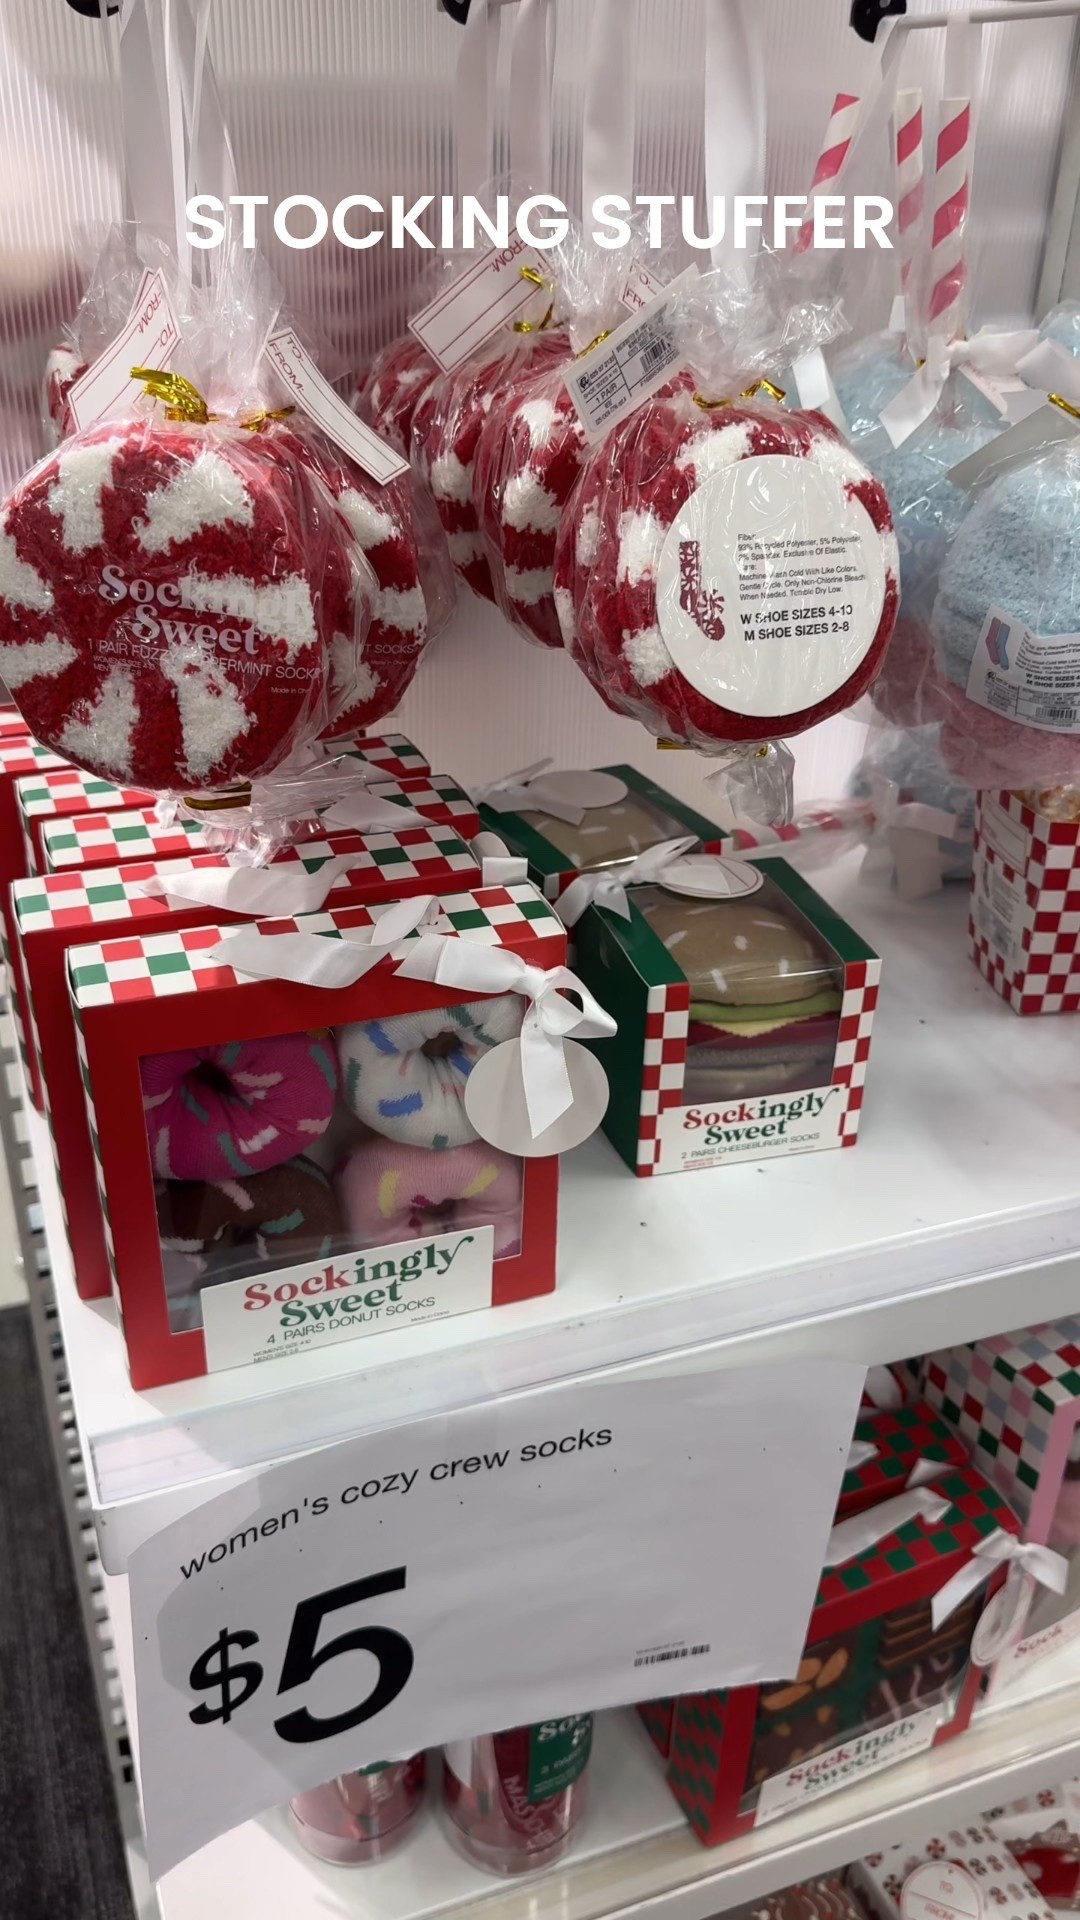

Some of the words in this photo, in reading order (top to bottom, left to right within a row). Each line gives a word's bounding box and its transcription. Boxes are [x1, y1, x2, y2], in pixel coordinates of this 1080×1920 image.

[159, 323, 174, 348] TO:
[286, 337, 304, 363] TO:
[269, 342, 305, 392] FROM:
[601, 382, 618, 400] PAIR
[815, 547, 824, 555] Of
[825, 546, 848, 555] Elastic.
[820, 537, 831, 545] 5%
[739, 573, 766, 581] Machine
[788, 568, 804, 577] Cold
[805, 567, 820, 576] With
[821, 565, 835, 574] Like
[740, 583, 762, 591] Gentle
[784, 579, 800, 588] Only
[801, 576, 843, 587] Non-Chlorine
[844, 574, 866, 583] Bleach
[740, 592, 760, 601] When
[815, 586, 828, 595] Dry
[827, 585, 844, 594] Low.
[740, 613, 752, 625] W
[755, 610, 789, 624] SHOE
[791, 606, 826, 621] SIZES
[828, 604, 853, 618] 4-10
[132, 604, 260, 655] Sweet
[744, 630, 755, 641] M
[758, 626, 792, 640] SHOE
[795, 622, 829, 637] SIZES
[831, 621, 850, 633] 2-8
[88, 638, 93, 650] 1
[98, 639, 128, 656] PAIR
[131, 644, 178, 662] FUZZY
[183, 650, 272, 677] PPERMINT
[374, 644, 414, 654] SOCKS
[683, 1087, 840, 1130] Sockingly
[704, 1119, 787, 1145] Sweet
[681, 1151, 688, 1159] 2
[691, 1147, 716, 1158] PAIRS
[717, 1138, 788, 1154] CHEESEBURGER
[789, 1132, 821, 1144] SOCKS
[244, 1236, 475, 1311] Sockingly
[280, 1279, 403, 1328] Sweet
[266, 1334, 276, 1345] 4
[284, 1322, 326, 1341] PAIRS
[329, 1308, 382, 1331] DONUT
[386, 1296, 436, 1317] SOCKS
[179, 1498, 329, 1580] women's
[340, 1469, 419, 1507] cozy
[428, 1448, 511, 1483] crew
[519, 1425, 614, 1464] socks
[188, 1565, 415, 1745] $5
[786, 1711, 932, 1788] Sockingly
[804, 1749, 879, 1791] Sweet
